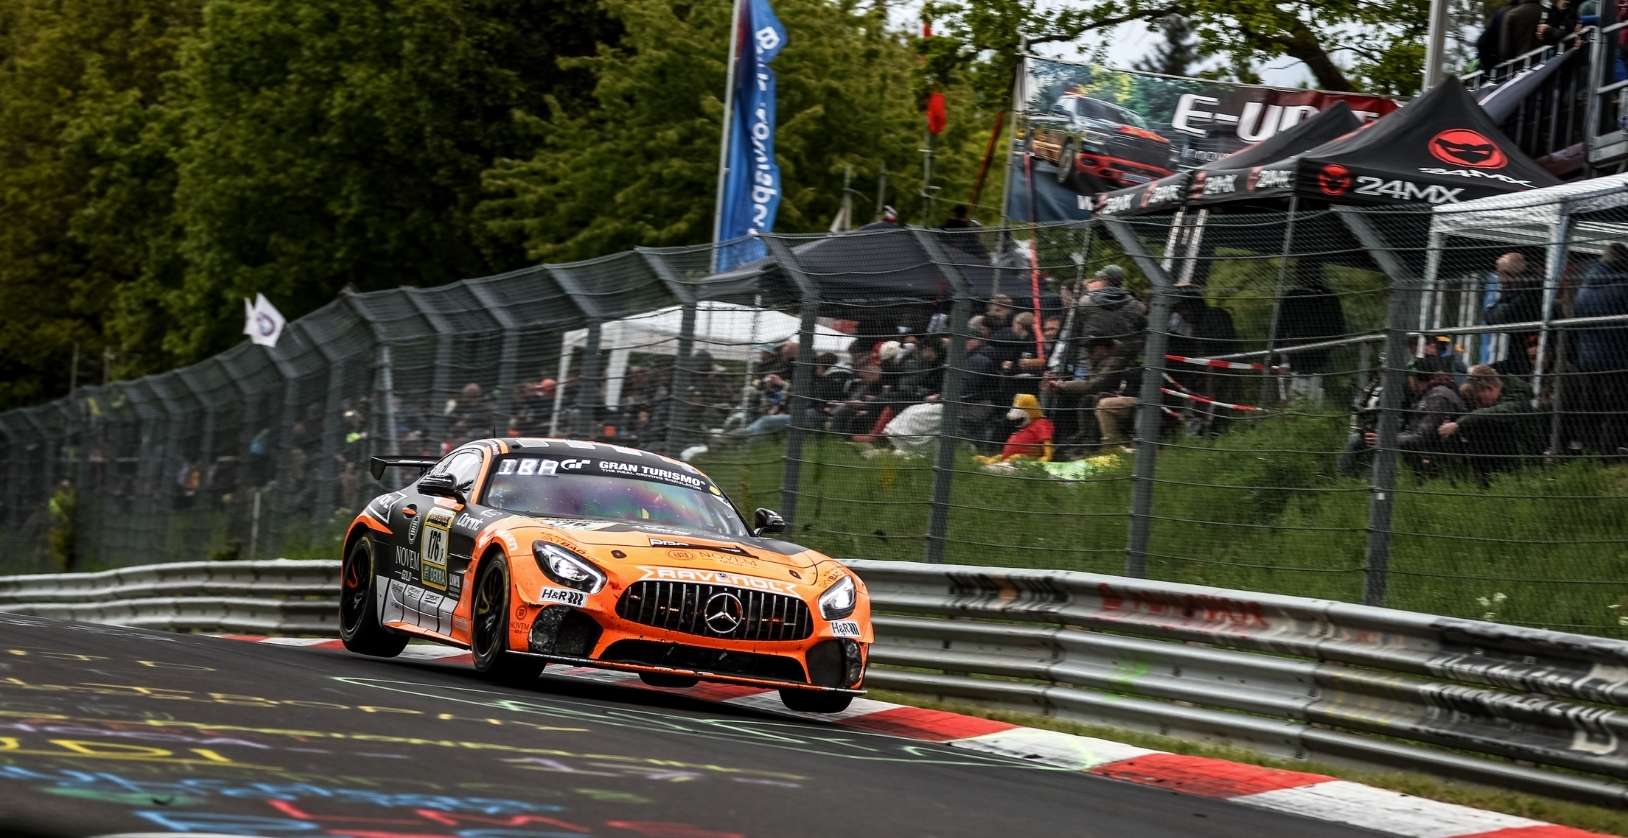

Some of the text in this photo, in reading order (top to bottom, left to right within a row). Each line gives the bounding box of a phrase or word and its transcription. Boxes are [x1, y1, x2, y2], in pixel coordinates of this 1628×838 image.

[1354, 176, 1465, 203] 24MX
[599, 461, 638, 472] GRAN
[395, 545, 420, 571] NOVEM
[656, 568, 779, 590] RAVENOL
[541, 588, 567, 600] H&R
[831, 622, 850, 634] H&R
